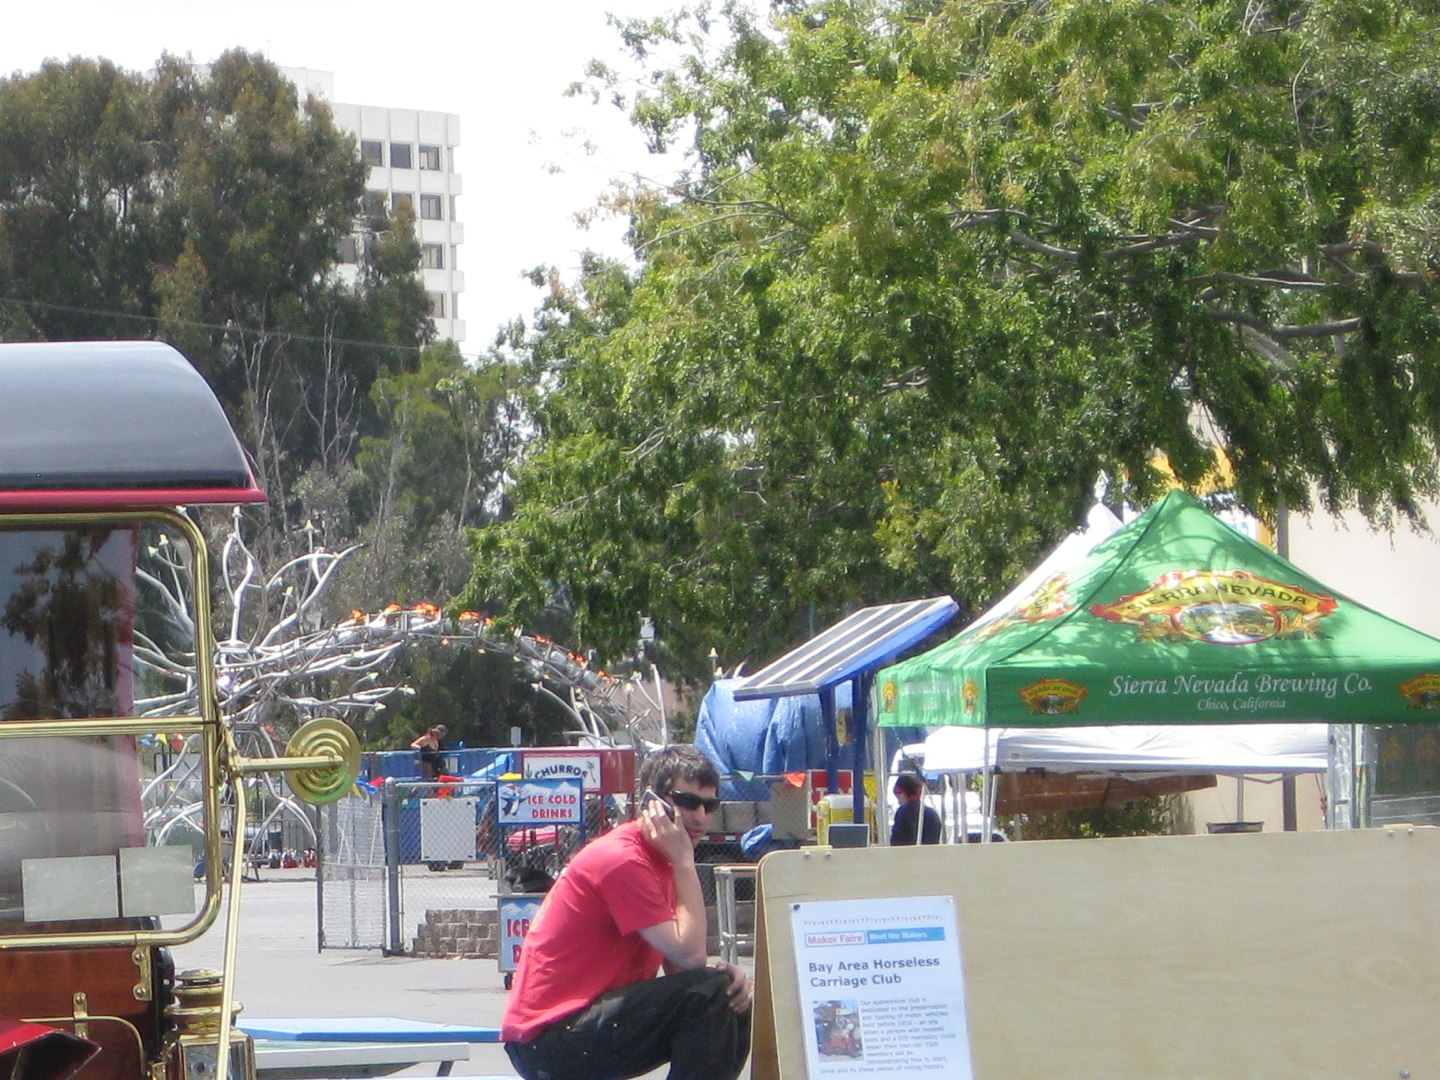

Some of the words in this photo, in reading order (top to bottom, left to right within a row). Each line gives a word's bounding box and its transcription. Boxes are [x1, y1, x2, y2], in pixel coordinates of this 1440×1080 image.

[1127, 586, 1208, 613] SIERRA
[1213, 584, 1308, 605] NEVADA
[1109, 674, 1167, 696] Sierra
[1173, 672, 1249, 695] Nevada
[1255, 673, 1337, 699] Brewing
[1343, 672, 1373, 694] Co.
[1197, 698, 1230, 712] Chico,
[1232, 696, 1286, 713] California
[534, 764, 589, 780] CHURROS
[528, 795, 544, 805] ICE
[548, 794, 577, 805] COLD
[531, 808, 573, 819] DRINKS
[807, 935, 837, 945] Maker
[840, 934, 863, 943] Faire
[809, 961, 834, 974] Bay
[838, 960, 869, 972] Area
[873, 957, 940, 969] Horseless
[810, 975, 868, 988] Carriage
[872, 973, 902, 985] Club
